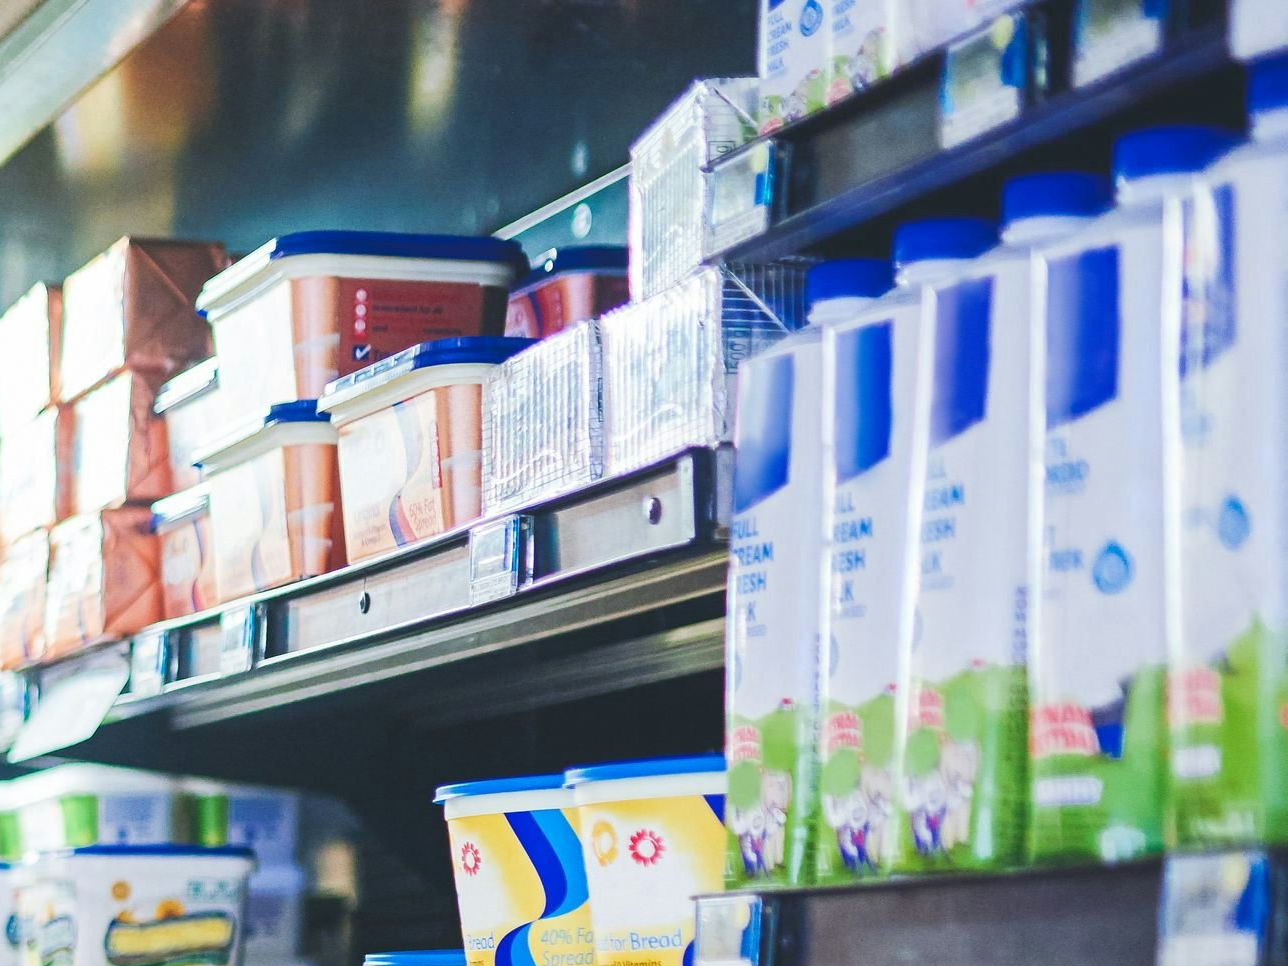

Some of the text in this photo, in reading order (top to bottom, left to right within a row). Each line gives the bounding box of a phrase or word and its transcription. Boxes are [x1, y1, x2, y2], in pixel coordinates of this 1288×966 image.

[540, 928, 572, 946] 40%
[577, 926, 594, 945] Fa
[629, 929, 683, 951] Bread
